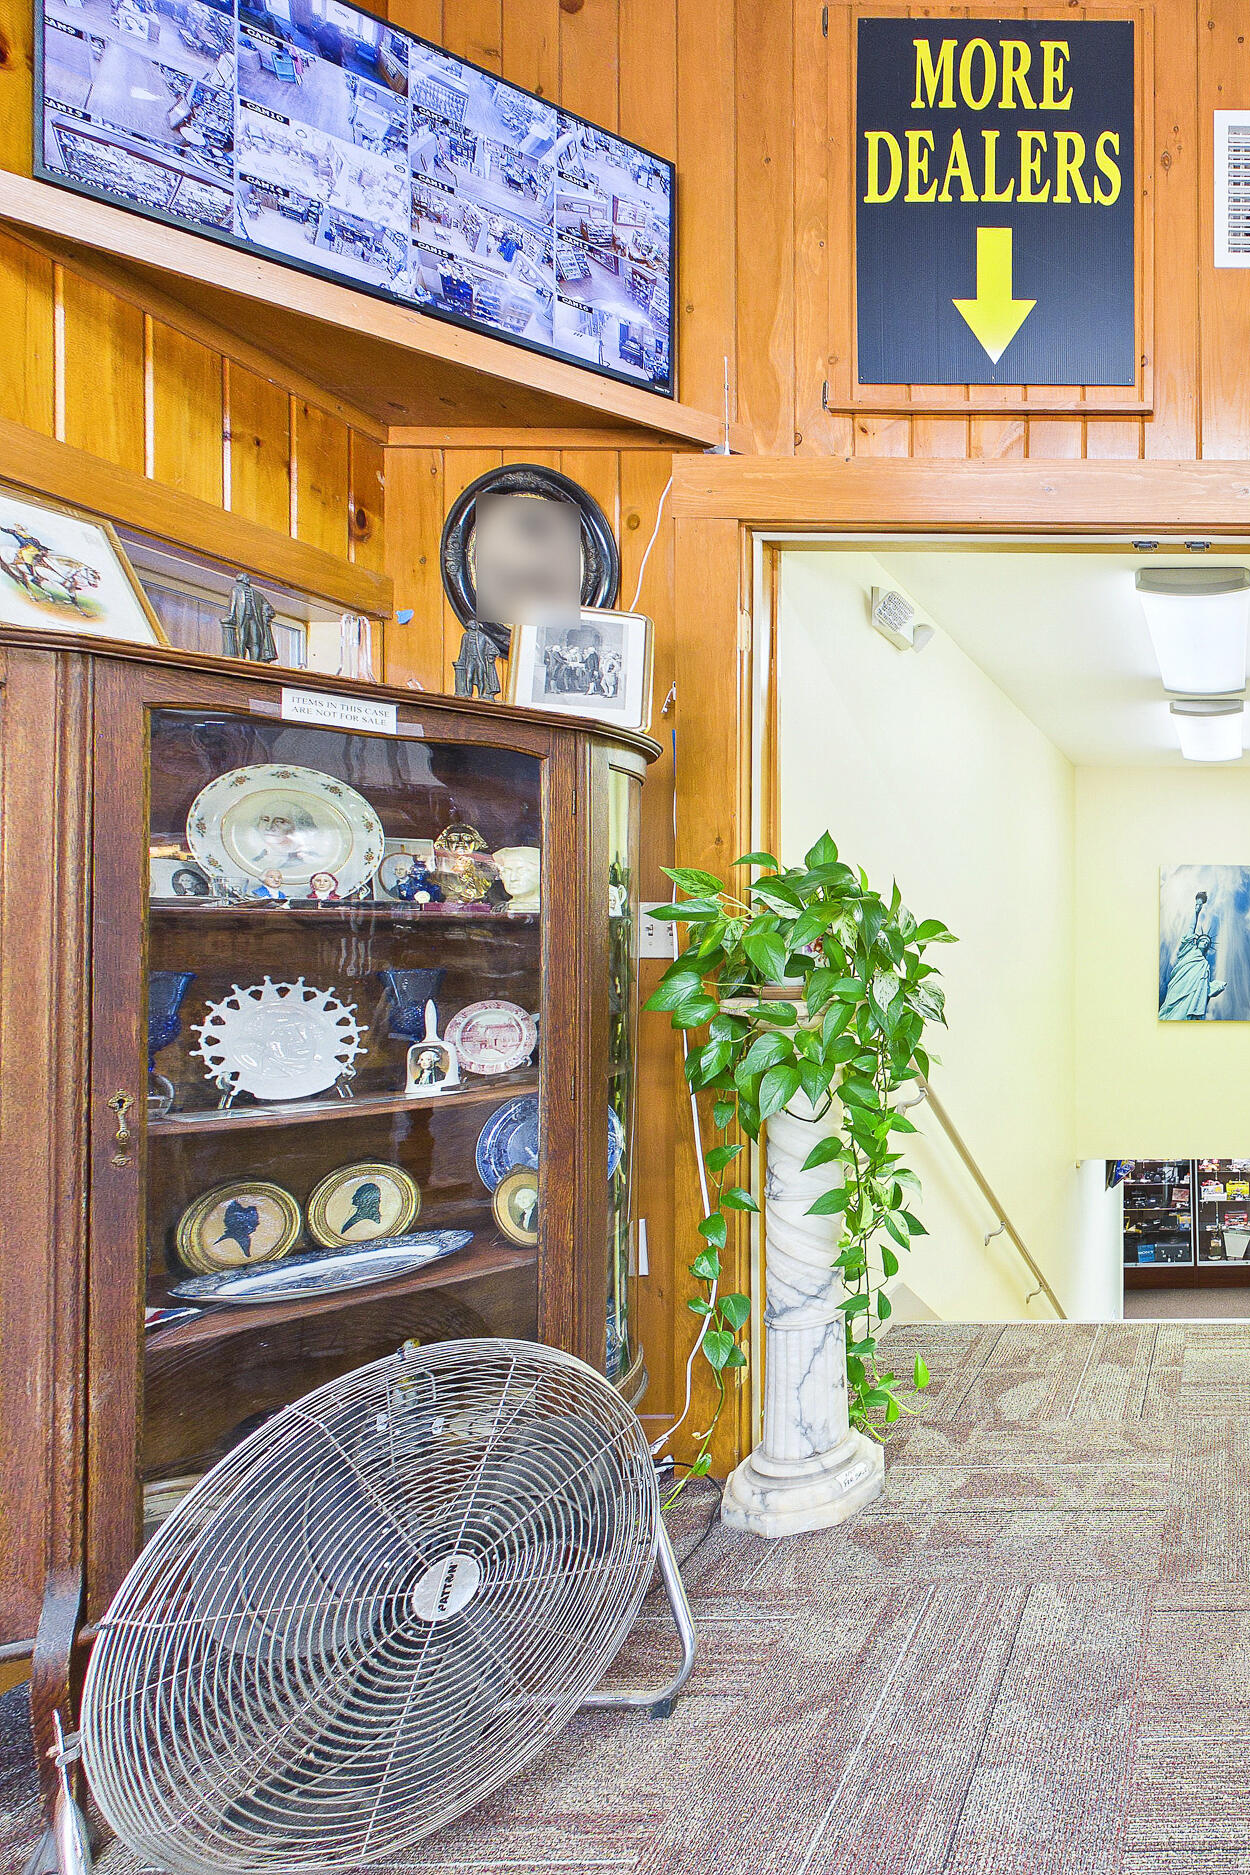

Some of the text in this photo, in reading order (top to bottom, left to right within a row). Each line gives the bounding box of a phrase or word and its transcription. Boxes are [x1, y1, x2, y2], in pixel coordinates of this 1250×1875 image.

[910, 37, 1074, 111] MORE
[863, 127, 1123, 207] DEALERS
[291, 696, 391, 718] ITEMS IN THIS CASE
[292, 706, 387, 727] ARE NOT FOR SALE
[438, 1562, 457, 1612] PATTON
